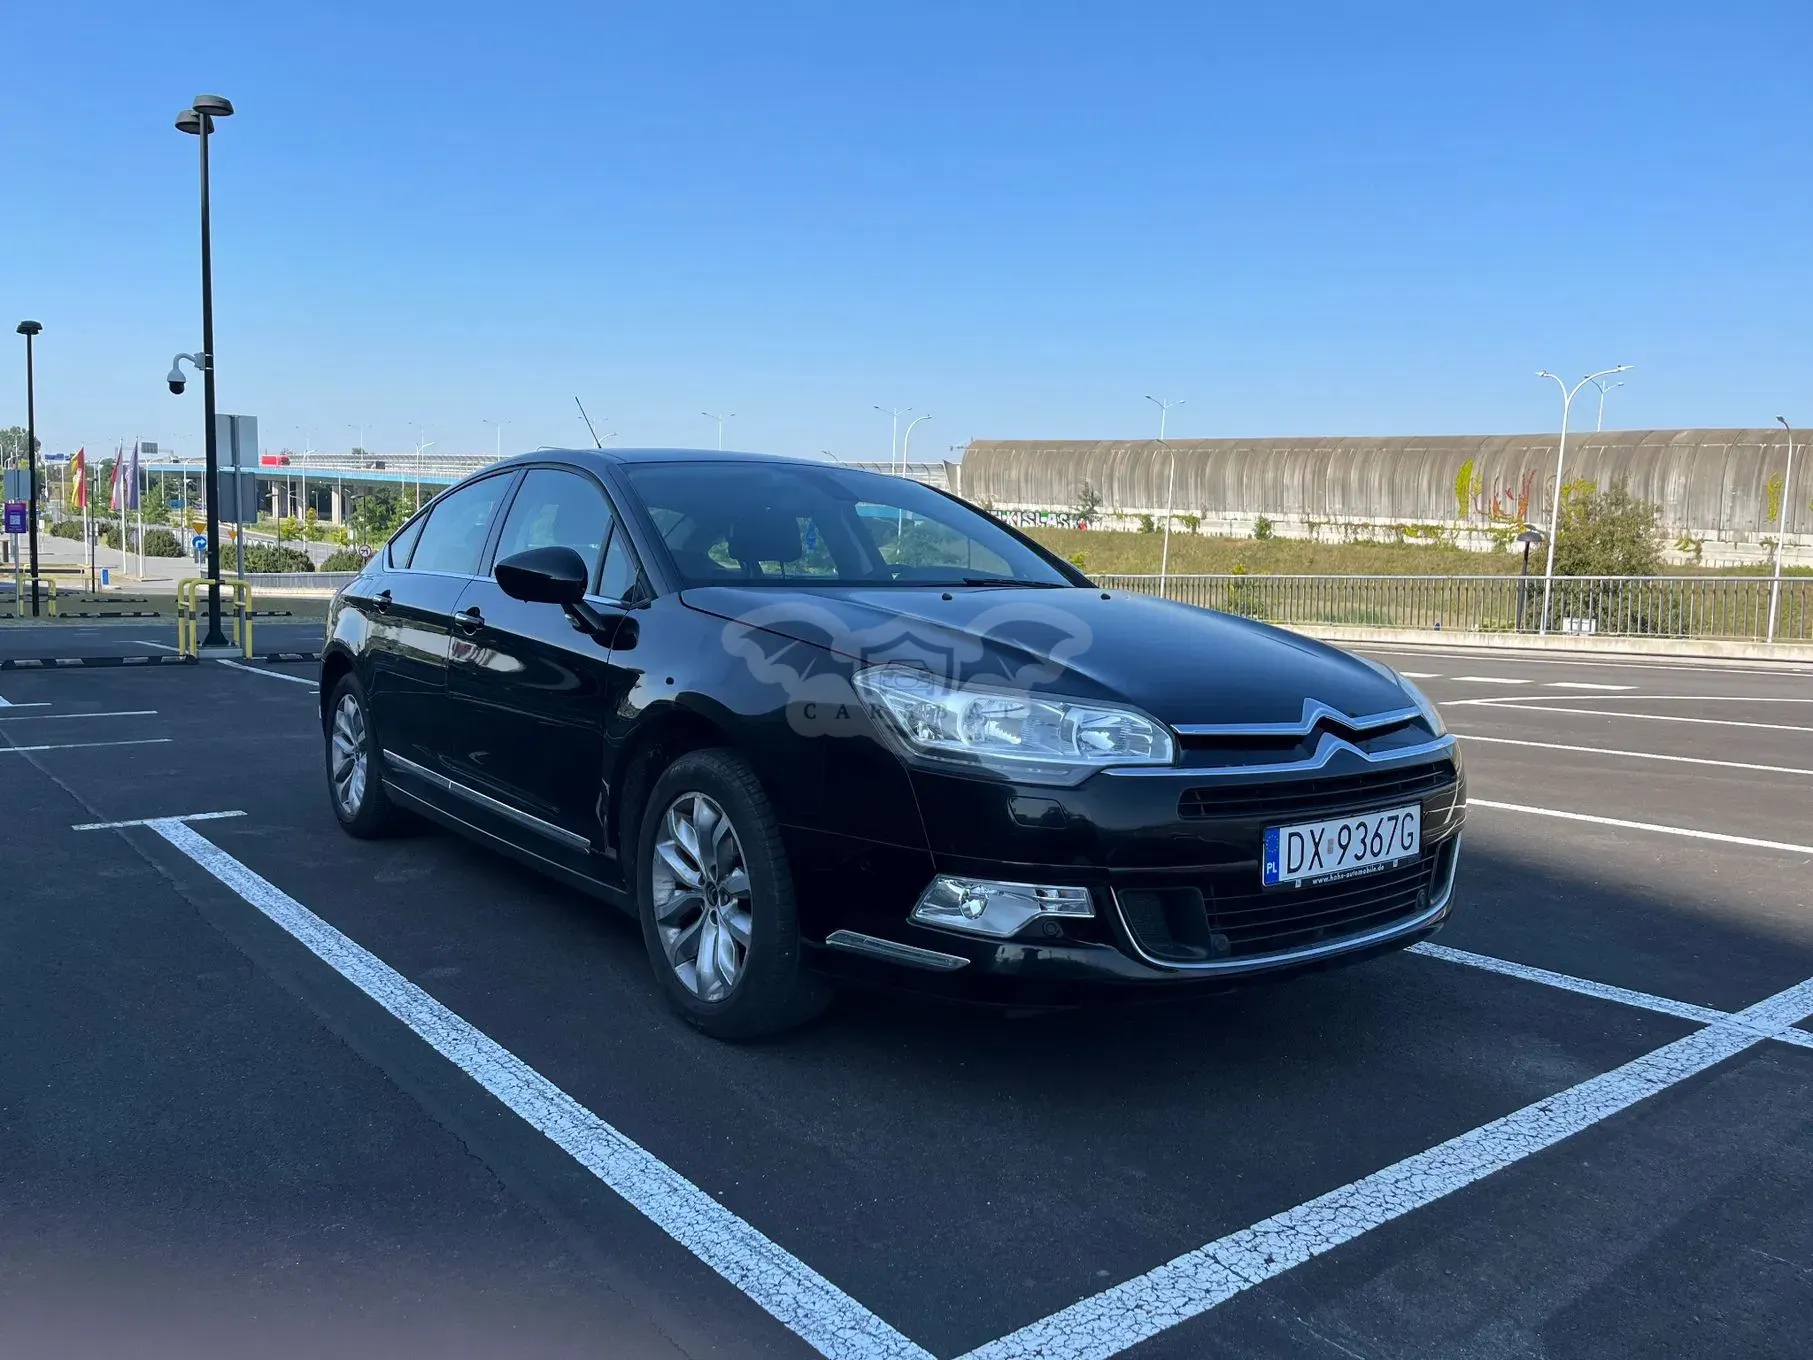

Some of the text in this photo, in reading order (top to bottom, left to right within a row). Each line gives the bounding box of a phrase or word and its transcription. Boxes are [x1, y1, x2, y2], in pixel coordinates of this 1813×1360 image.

[1287, 812, 1414, 874] DX 9367G
[1266, 862, 1278, 875] PL
